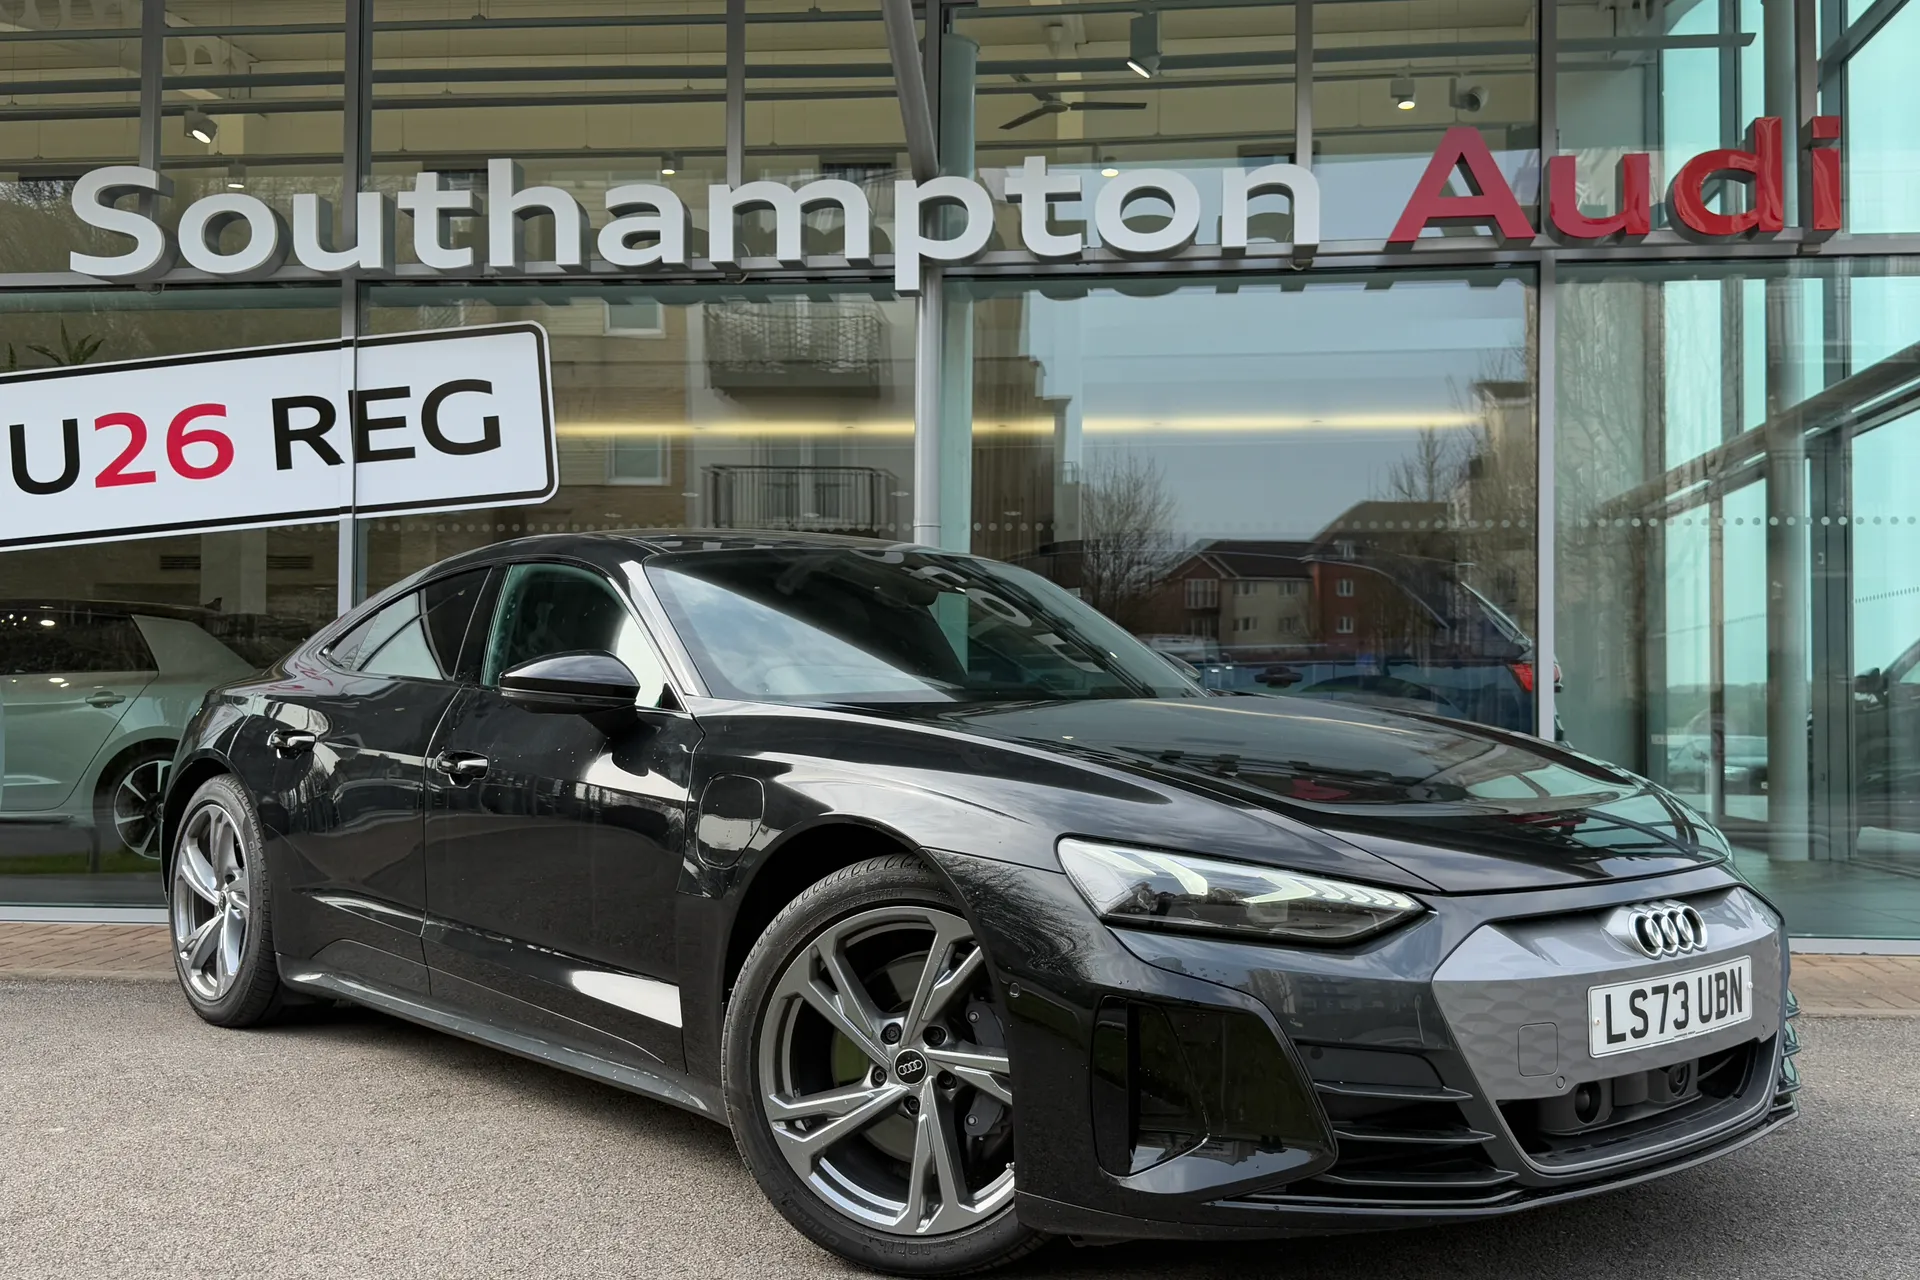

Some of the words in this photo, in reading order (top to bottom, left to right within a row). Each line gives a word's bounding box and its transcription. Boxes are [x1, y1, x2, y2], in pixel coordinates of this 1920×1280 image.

[70, 156, 1321, 294] Southampton
[1386, 115, 1841, 249] Audi
[9, 403, 235, 495] U26
[272, 378, 502, 471] REG
[1604, 981, 1690, 1045] LS73
[1697, 966, 1743, 1025] UBN
